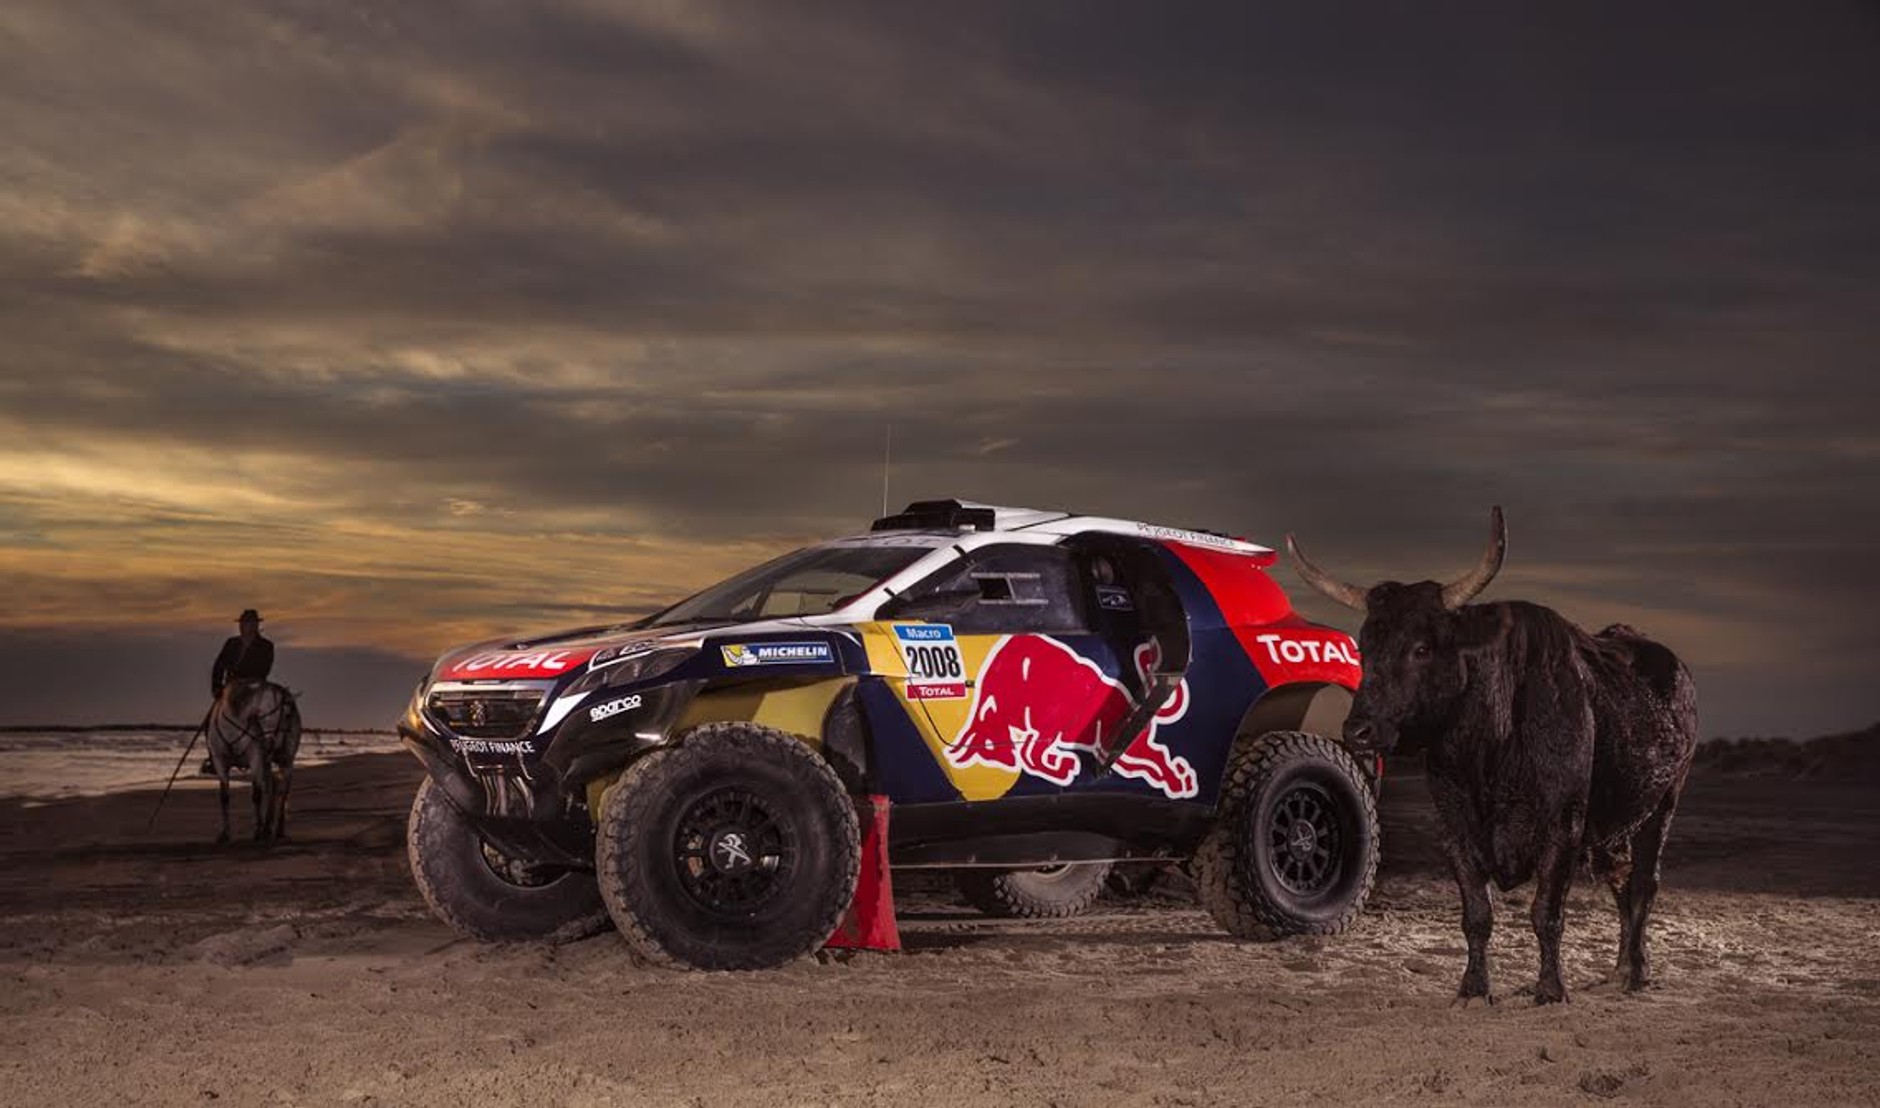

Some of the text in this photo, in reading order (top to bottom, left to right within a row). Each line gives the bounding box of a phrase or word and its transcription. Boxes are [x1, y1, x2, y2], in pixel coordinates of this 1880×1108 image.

[905, 628, 941, 639] Macro
[758, 646, 827, 657] MICHELIN
[1256, 633, 1360, 666] TOTAL
[452, 651, 571, 672] TOTAL
[906, 646, 961, 678] 2008
[918, 686, 955, 696] TOTAL
[489, 740, 535, 755] FINANCE
